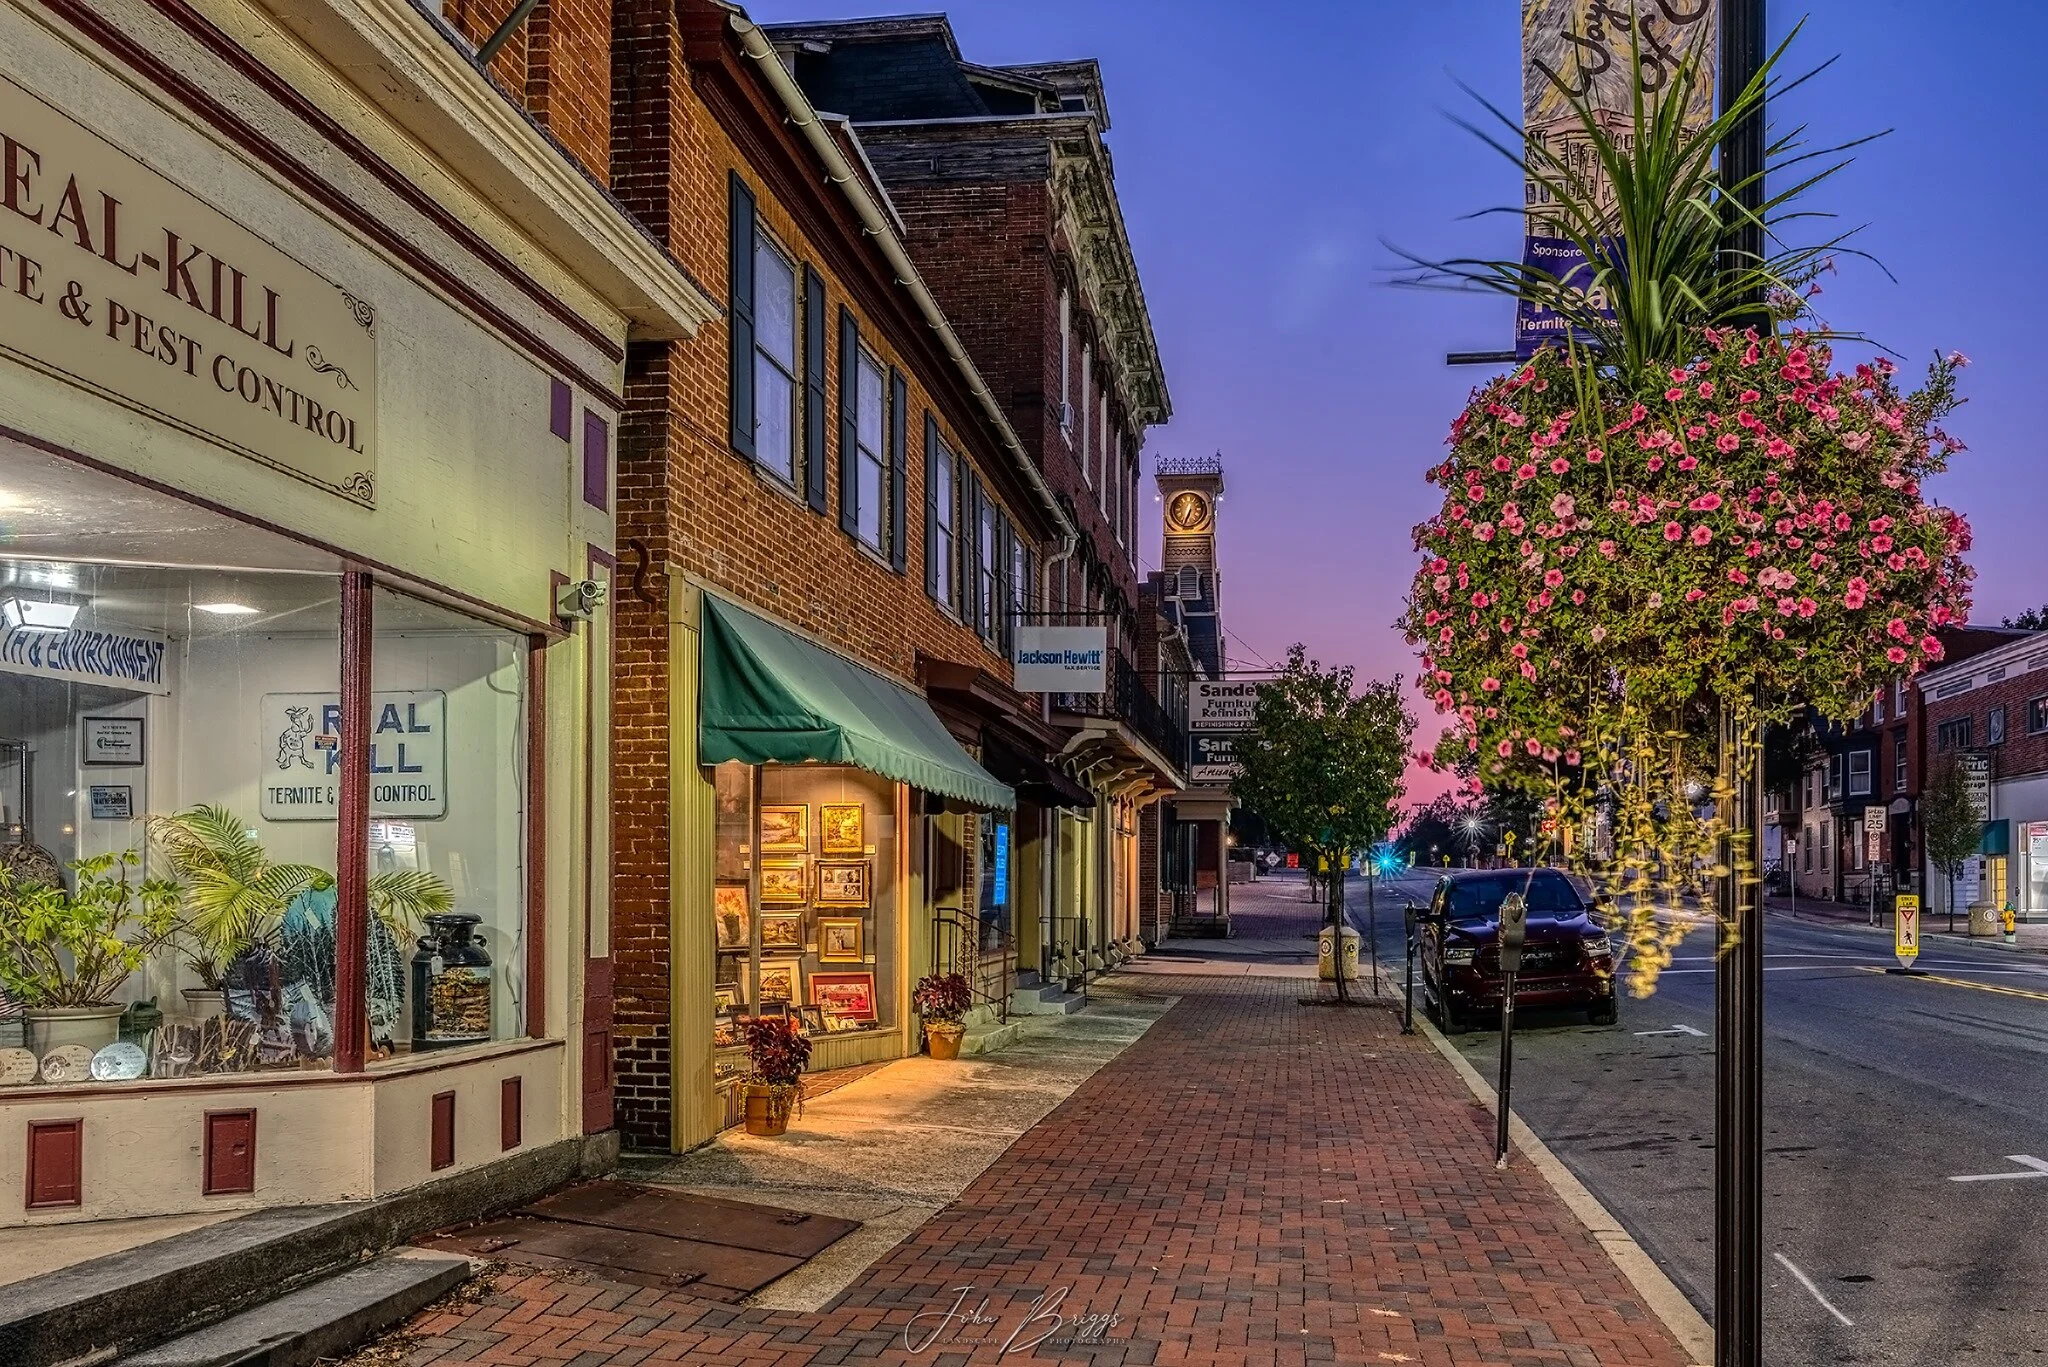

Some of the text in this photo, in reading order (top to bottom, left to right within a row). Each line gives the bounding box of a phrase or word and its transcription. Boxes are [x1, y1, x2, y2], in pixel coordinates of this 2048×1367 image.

[1532, 242, 1587, 258] Sponsore
[1593, 317, 1621, 328] Pes
[59, 280, 92, 327] &
[106, 297, 202, 378] PEST
[212, 353, 364, 455] CONTROL
[47, 628, 165, 684] ENVIRONMENT
[1018, 650, 1100, 664] Jackson Hewitt
[322, 703, 431, 735] RAL
[1198, 738, 1273, 752] Sanrs
[325, 743, 423, 775] KLL
[268, 784, 436, 805] TERMITE & CONTROL
[1867, 820, 1883, 829] 25
